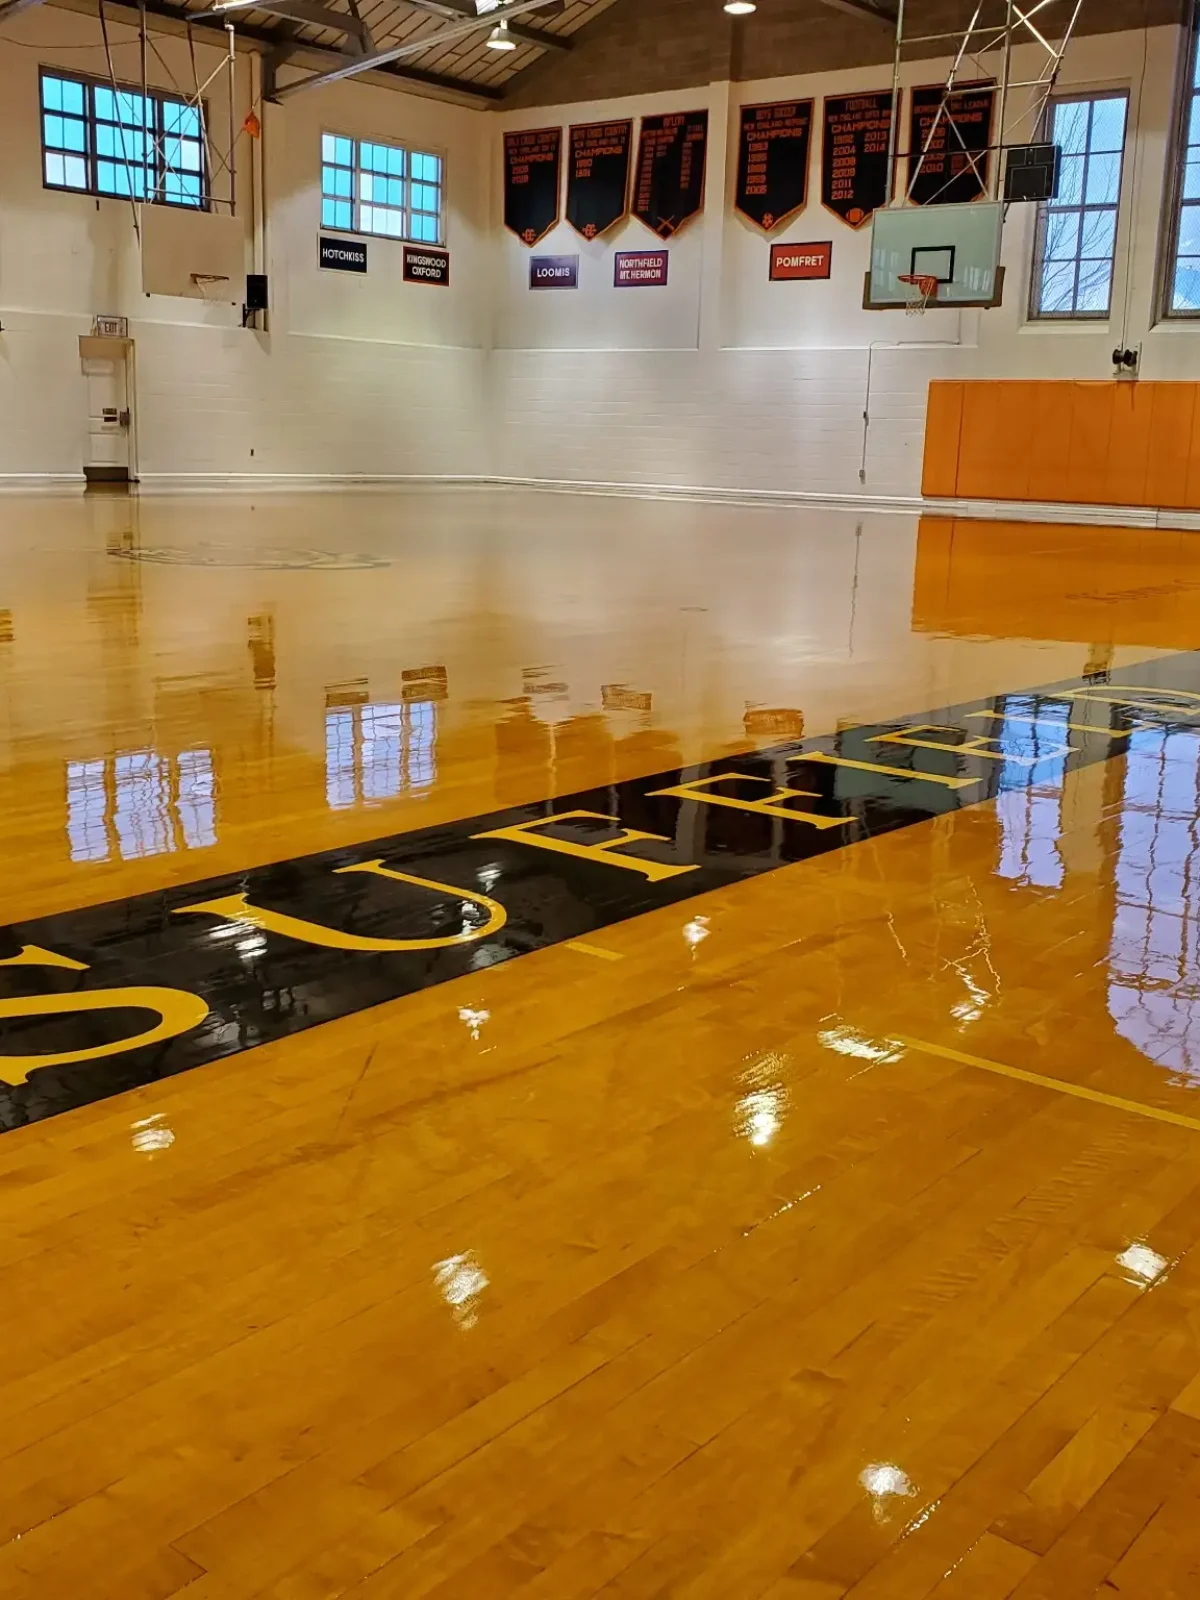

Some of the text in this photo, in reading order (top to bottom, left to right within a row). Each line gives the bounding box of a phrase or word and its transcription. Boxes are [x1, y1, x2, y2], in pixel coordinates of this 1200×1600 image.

[833, 145, 856, 156] 2004
[864, 142, 886, 153] 2014
[831, 179, 851, 190] 2011
[831, 190, 854, 200] 2012
[322, 247, 364, 262] HOTCHKISS
[406, 253, 447, 269] KINGSWOOD
[619, 257, 664, 270] NORTHFIELD
[776, 254, 825, 268] POMFRET
[411, 266, 442, 279] OXFORD
[536, 267, 571, 278] LOOMIS
[631, 268, 662, 279] HERMON
